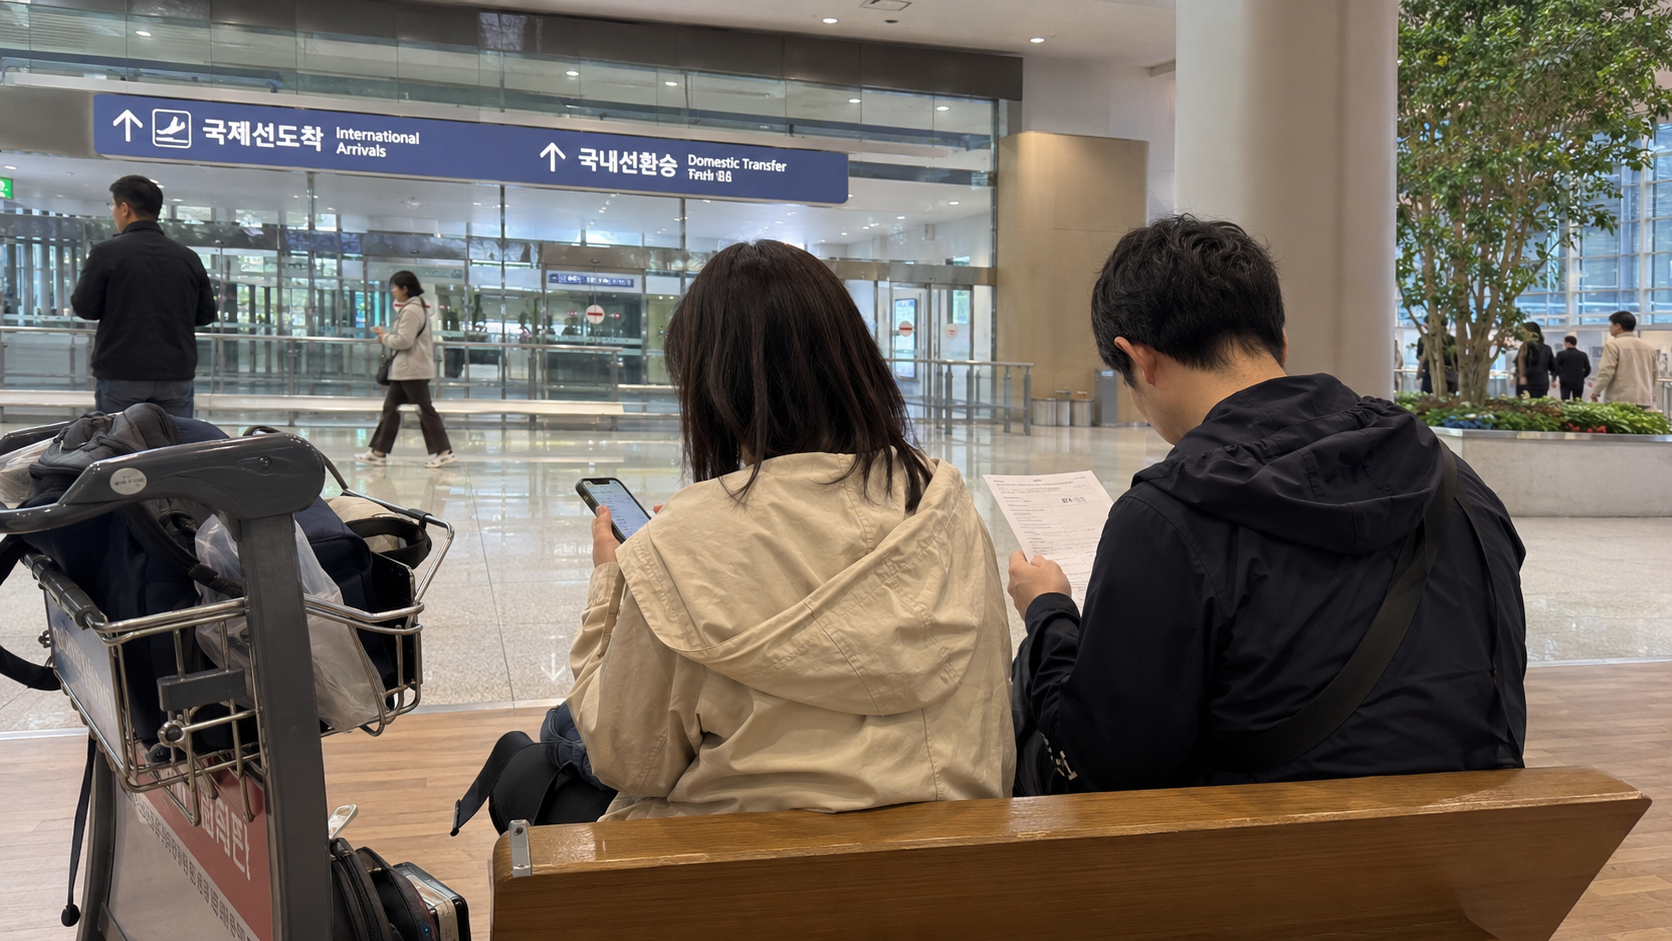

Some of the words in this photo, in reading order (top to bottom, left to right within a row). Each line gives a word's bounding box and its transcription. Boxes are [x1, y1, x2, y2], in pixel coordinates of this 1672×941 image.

[202, 118, 325, 152] 국제선도착
[335, 126, 420, 146] International
[335, 142, 387, 158] Arrivals
[577, 147, 679, 178] 국내선환승
[687, 153, 740, 169] Domestic
[741, 157, 788, 172] Transfer
